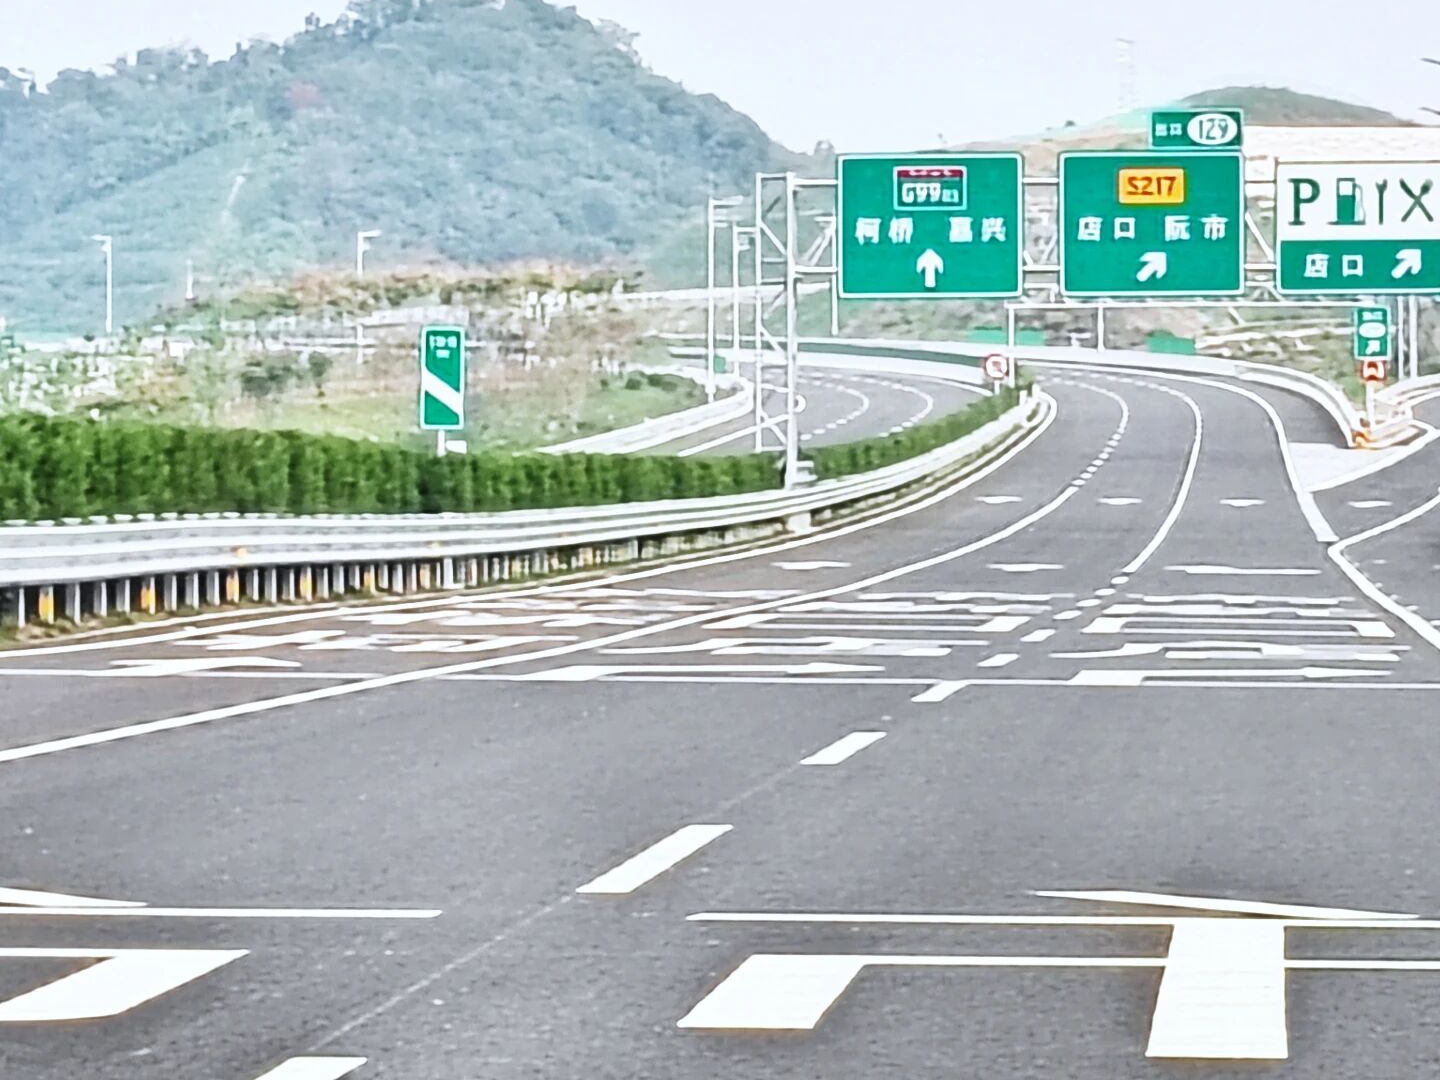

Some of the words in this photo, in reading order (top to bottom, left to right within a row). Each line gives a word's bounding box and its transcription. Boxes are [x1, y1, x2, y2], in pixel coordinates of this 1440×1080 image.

[1198, 118, 1229, 140] 129
[1126, 176, 1177, 196] S217
[1077, 215, 1136, 242] 店口
[1303, 253, 1364, 278] 店口
